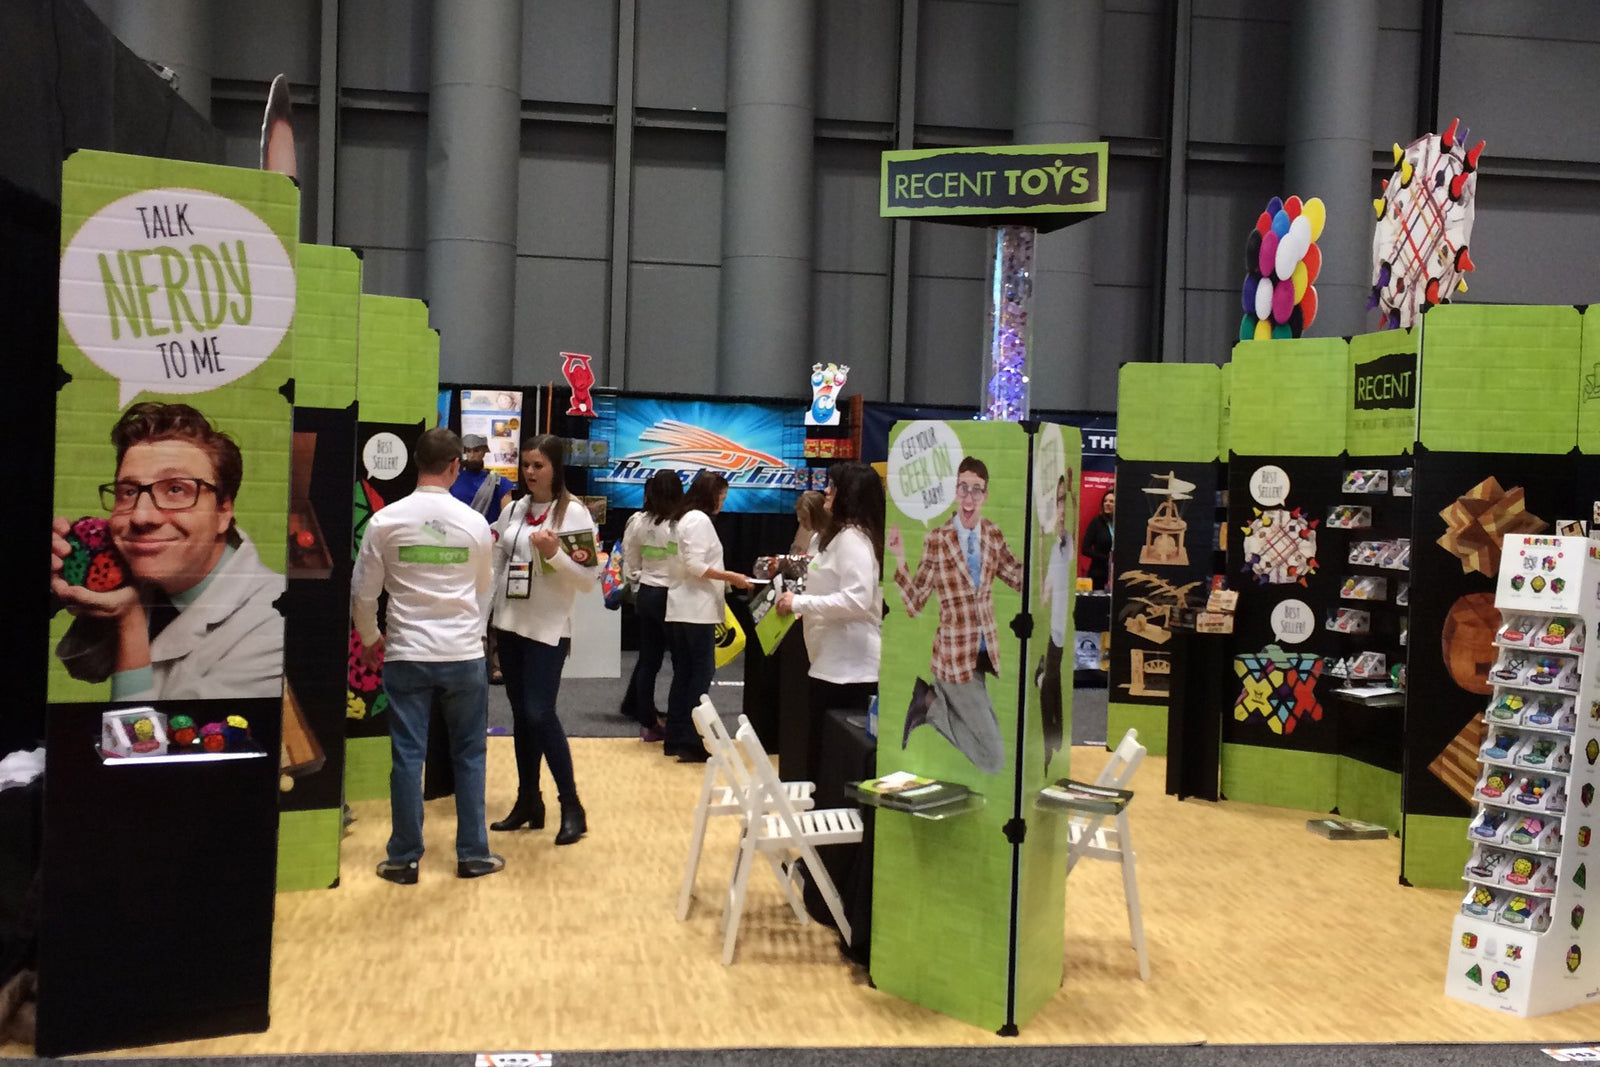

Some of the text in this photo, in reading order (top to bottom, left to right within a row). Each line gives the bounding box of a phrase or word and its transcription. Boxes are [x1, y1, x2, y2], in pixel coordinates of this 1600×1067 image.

[895, 159, 1089, 199] RECENT TOYS
[136, 203, 194, 238] TALK
[97, 240, 253, 341] NERDY
[156, 336, 225, 379] TO ME
[1358, 371, 1412, 401] RECENT
[901, 427, 937, 460] GET YOUR
[899, 442, 953, 497] GEEK ON
